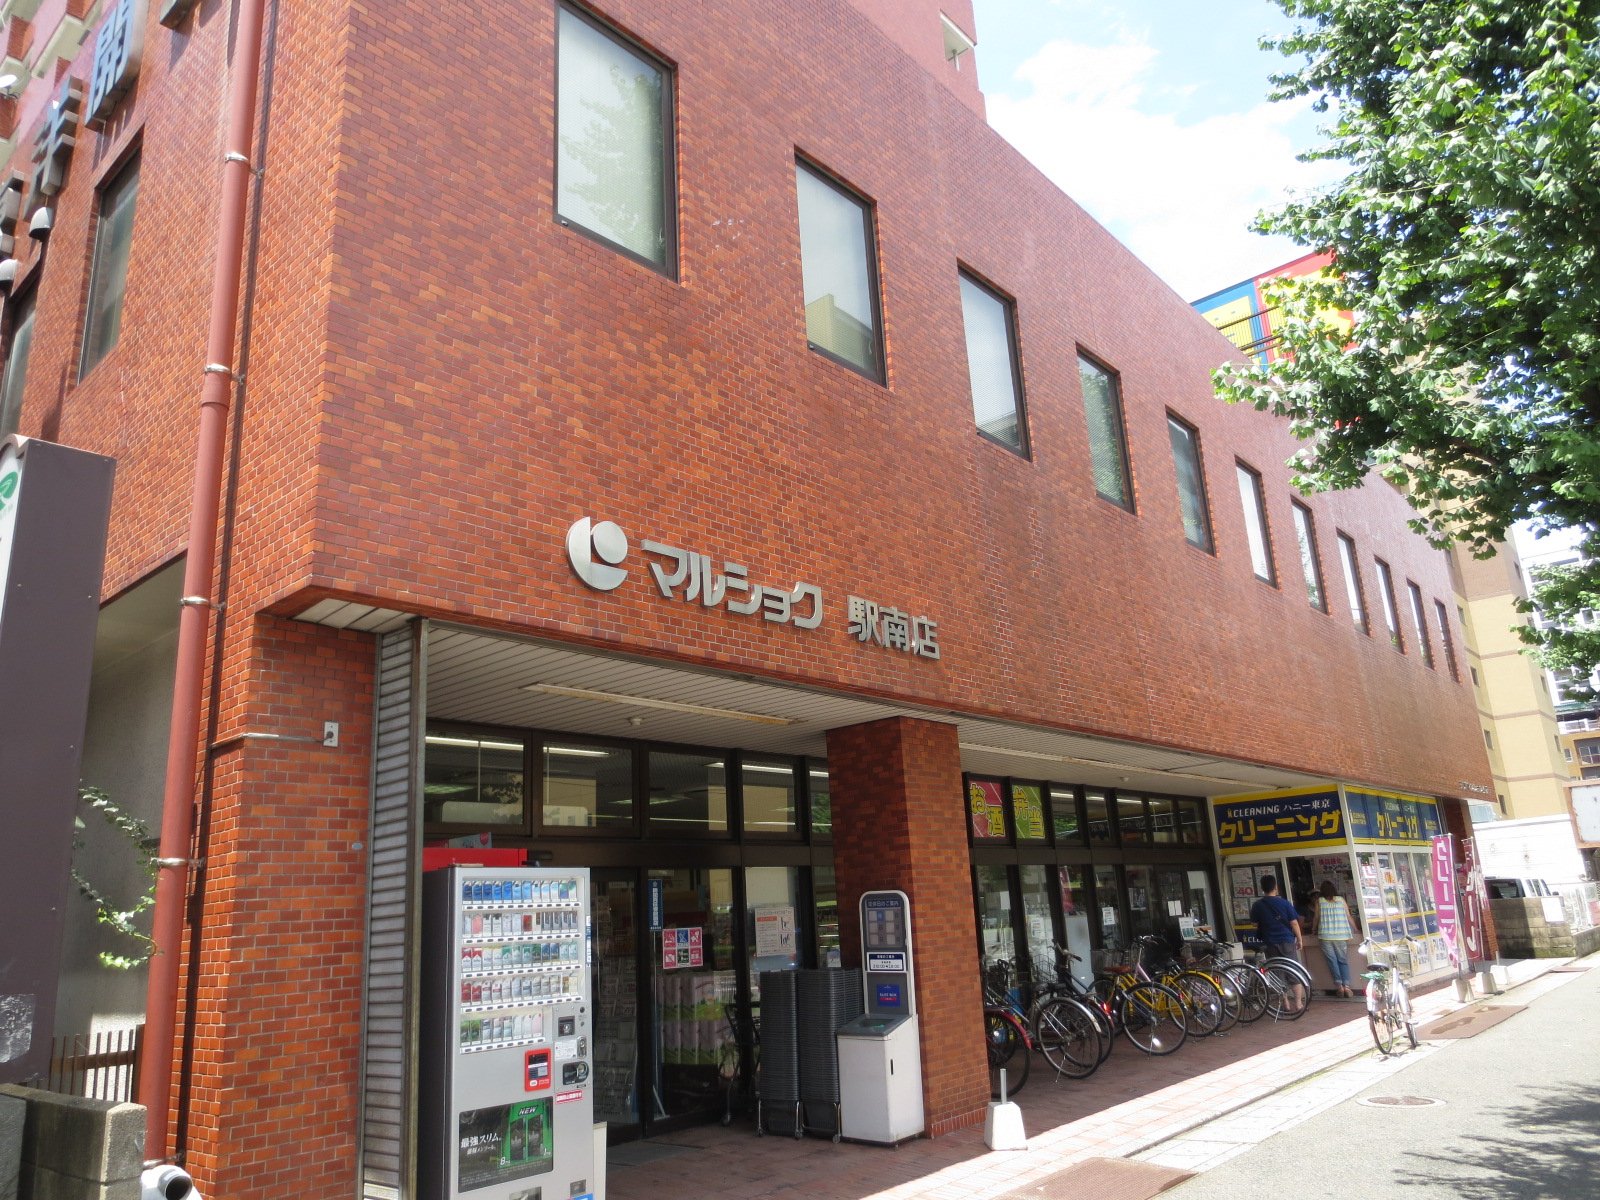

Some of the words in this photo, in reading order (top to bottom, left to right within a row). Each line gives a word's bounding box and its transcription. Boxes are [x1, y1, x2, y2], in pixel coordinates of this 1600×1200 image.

[641, 538, 823, 630] マルショク
[847, 594, 940, 660] 駅南店
[1233, 804, 1280, 818] CLEANING
[1283, 798, 1331, 812] ハニー東京
[1219, 809, 1342, 844] クリーニング
[1376, 812, 1419, 839] クリーニング
[518, 1106, 537, 1115] NEW
